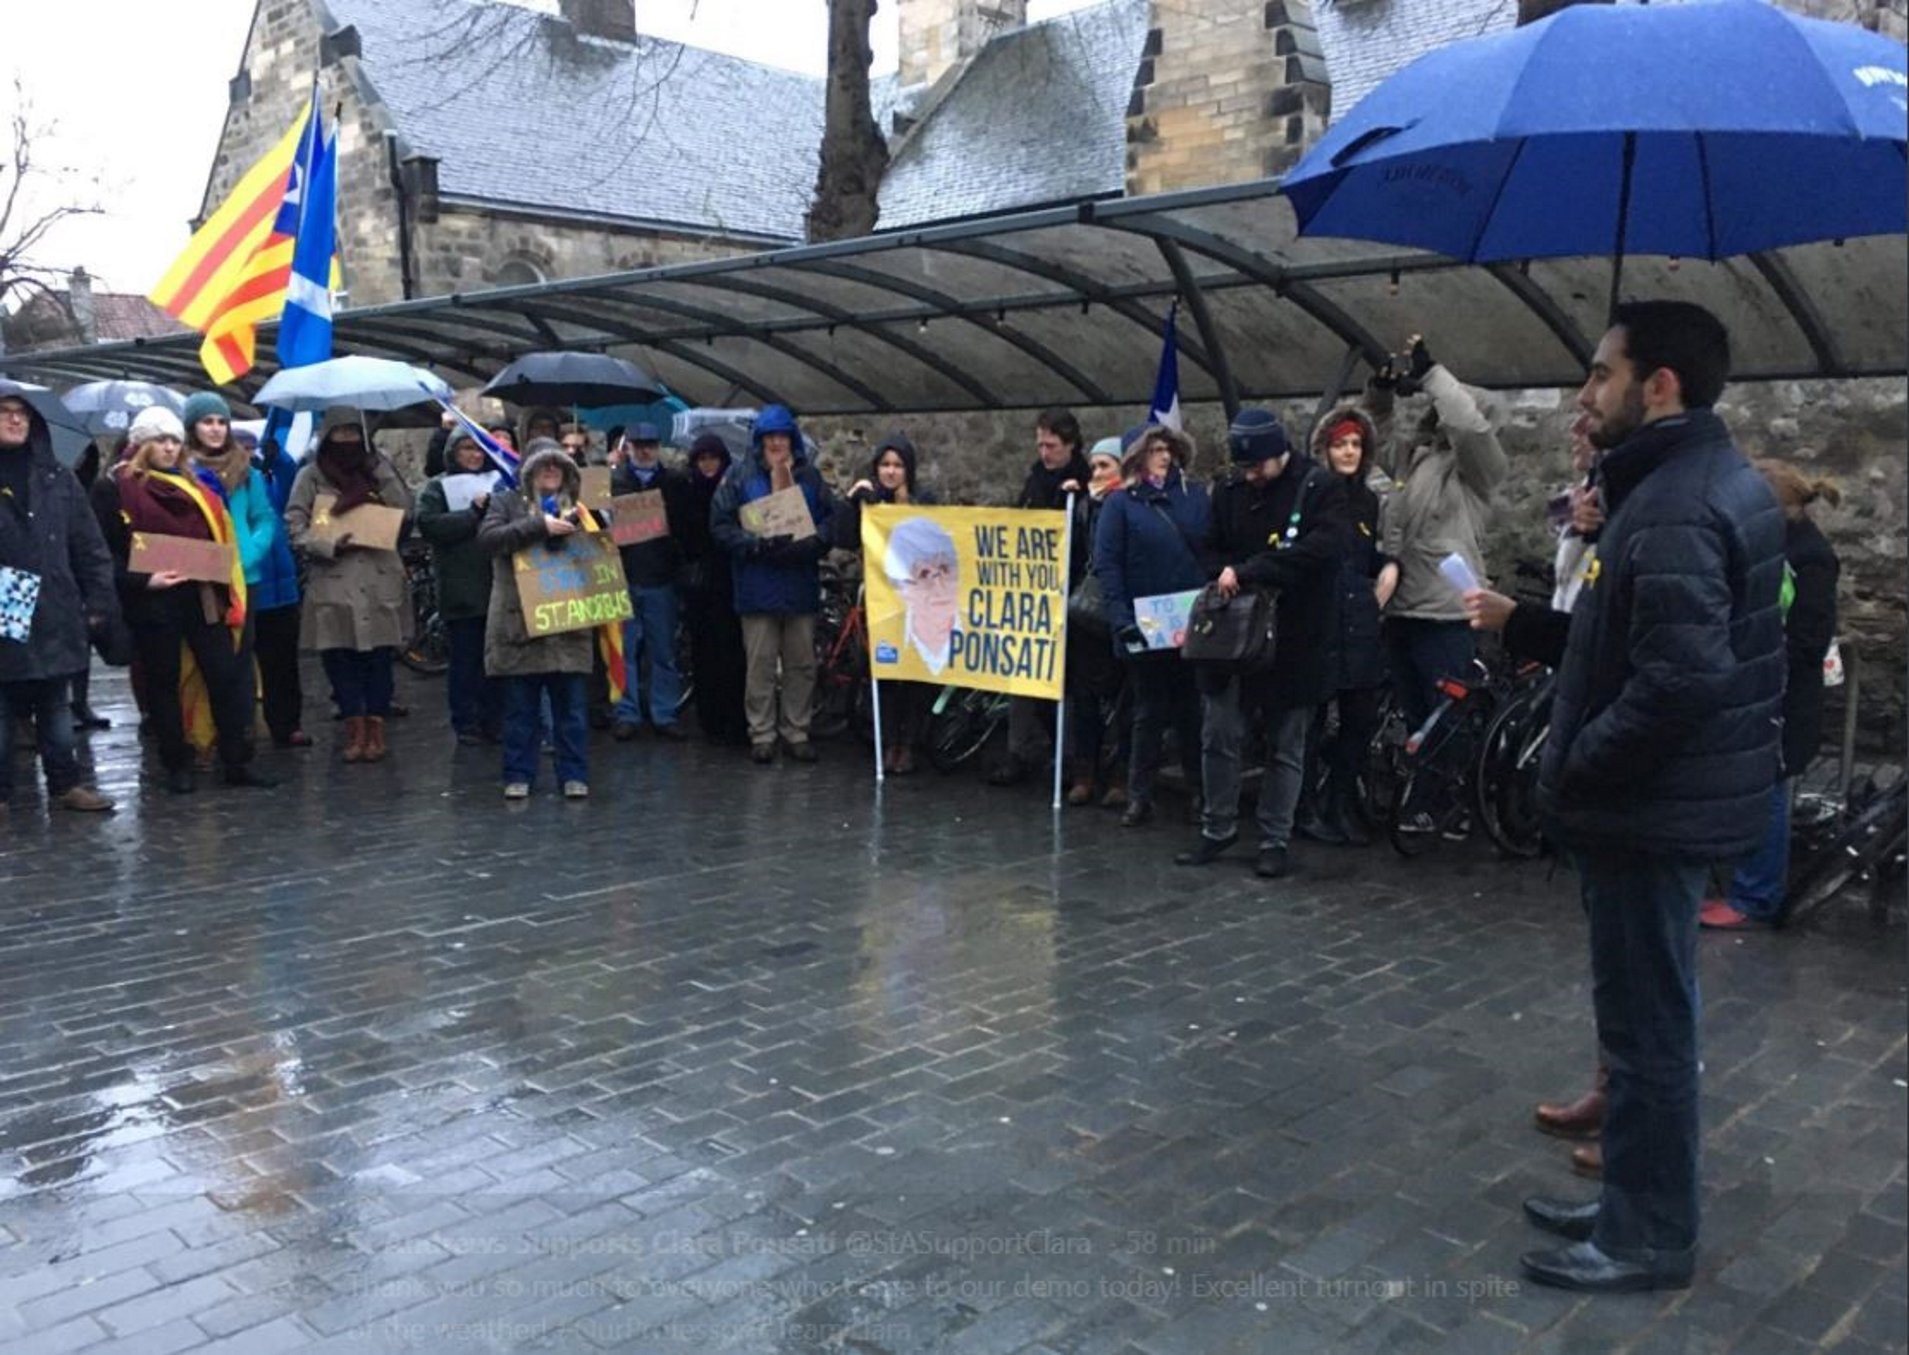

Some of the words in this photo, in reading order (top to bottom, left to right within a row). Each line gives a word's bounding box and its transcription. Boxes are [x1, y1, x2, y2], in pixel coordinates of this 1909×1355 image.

[975, 525, 1008, 558] WE
[1016, 526, 1058, 561] ARE
[976, 562, 1021, 589] WITH
[968, 590, 1051, 634] CLARA
